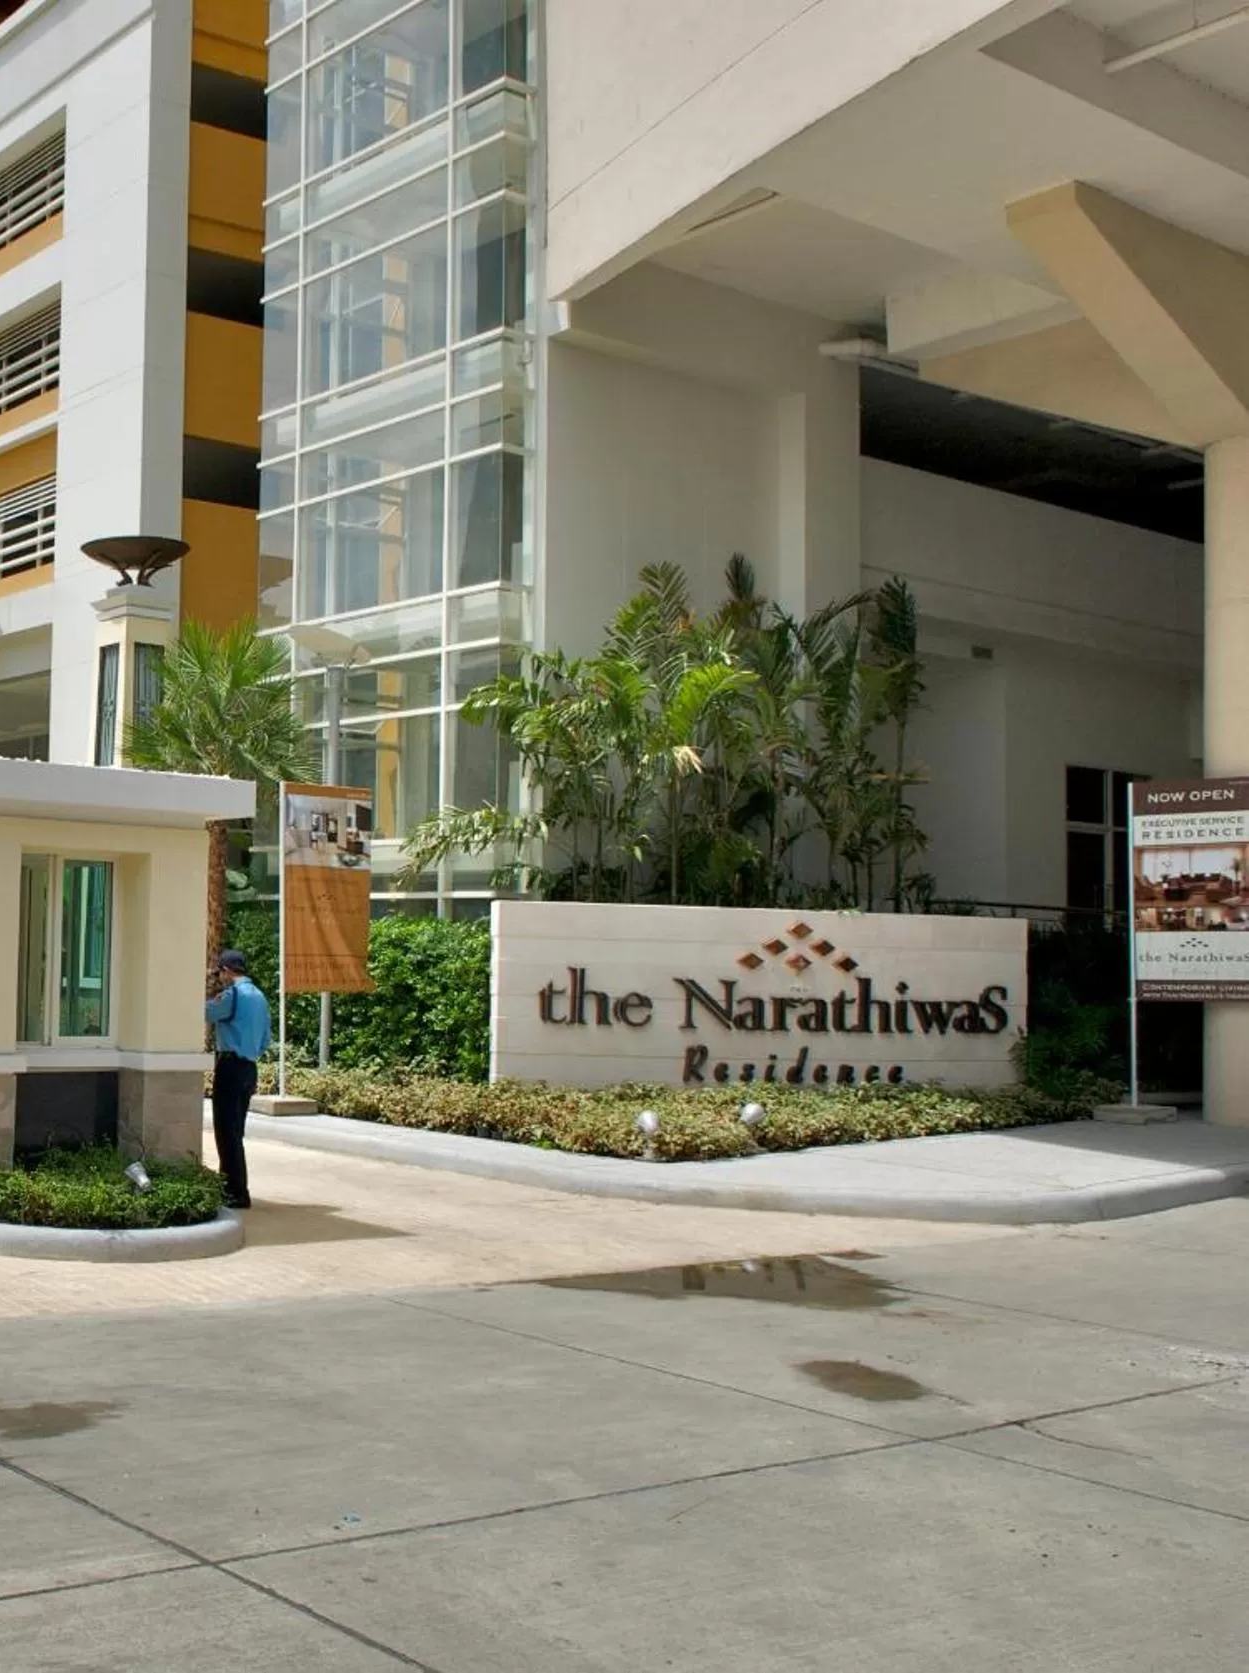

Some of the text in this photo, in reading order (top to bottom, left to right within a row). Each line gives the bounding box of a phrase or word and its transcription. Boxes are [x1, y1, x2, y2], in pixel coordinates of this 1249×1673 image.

[1147, 788, 1235, 804] NOW OPEN
[1199, 815, 1246, 824] SERVICE
[1141, 827, 1245, 840] RESIDENCE
[537, 966, 652, 1028] the
[682, 1043, 904, 1085] Residence
